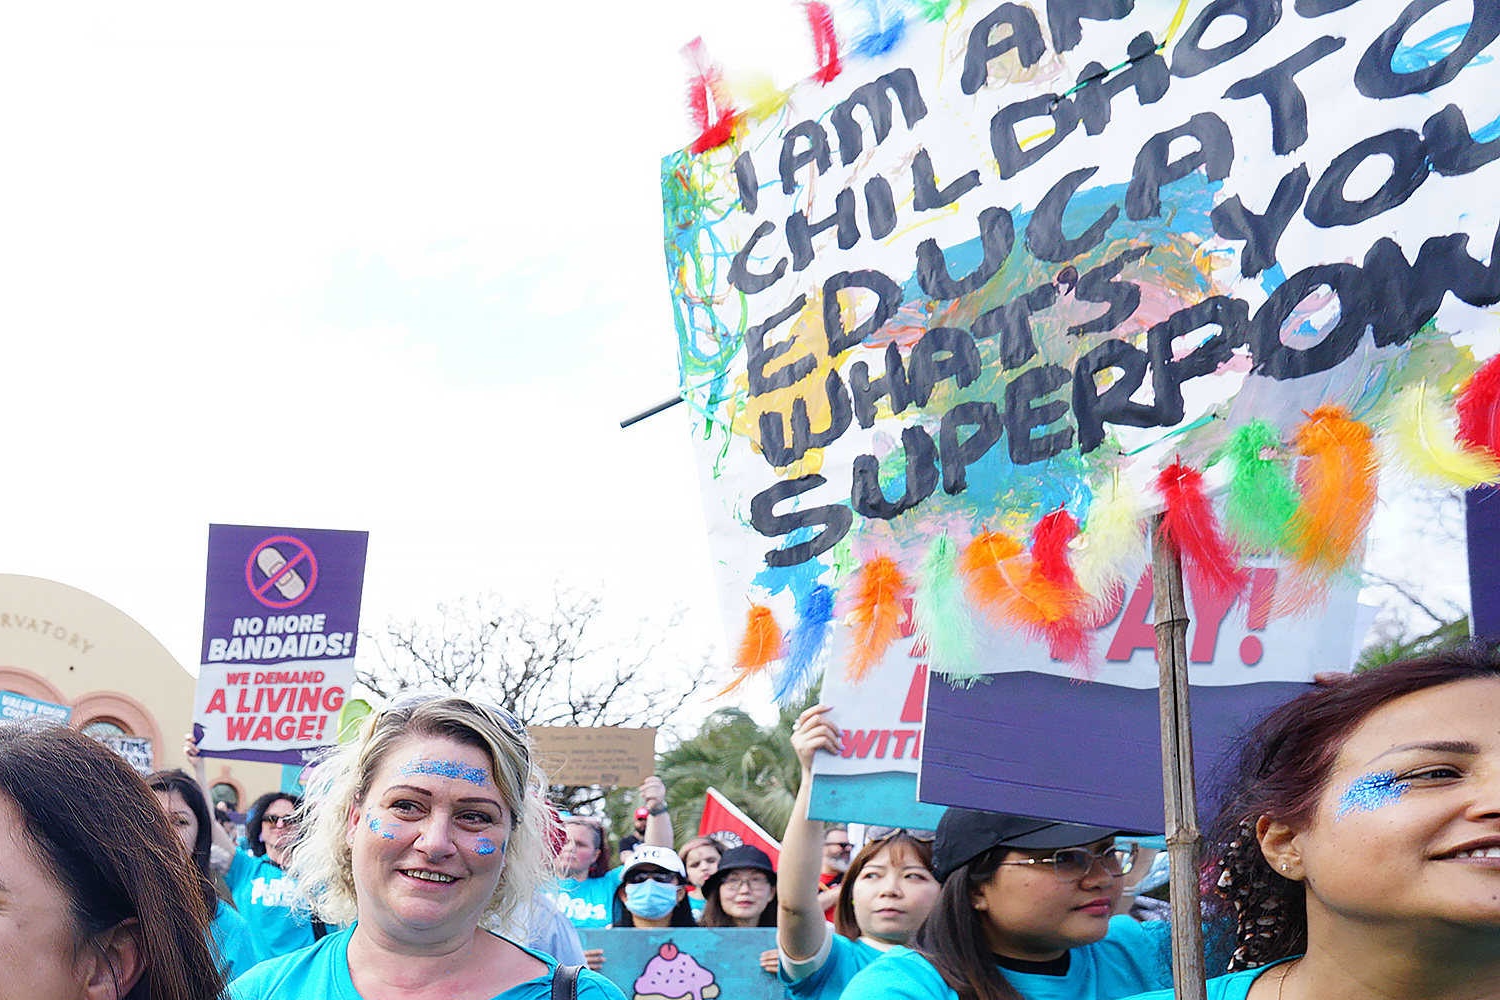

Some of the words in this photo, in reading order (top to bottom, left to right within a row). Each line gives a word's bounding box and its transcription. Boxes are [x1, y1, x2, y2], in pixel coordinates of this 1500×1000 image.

[727, 0, 1360, 295] CHILDHO
[734, 150, 758, 215] I
[779, 67, 928, 195] AM
[759, 245, 1154, 468] WHAT'S
[232, 616, 265, 637] NO
[265, 613, 327, 635] MORE
[207, 631, 354, 662] BANDAIDS!
[226, 671, 250, 686] WE
[253, 670, 326, 686] DEMAND
[204, 688, 227, 714] A
[235, 686, 345, 715] LIVING
[226, 715, 328, 742] WAGE!
